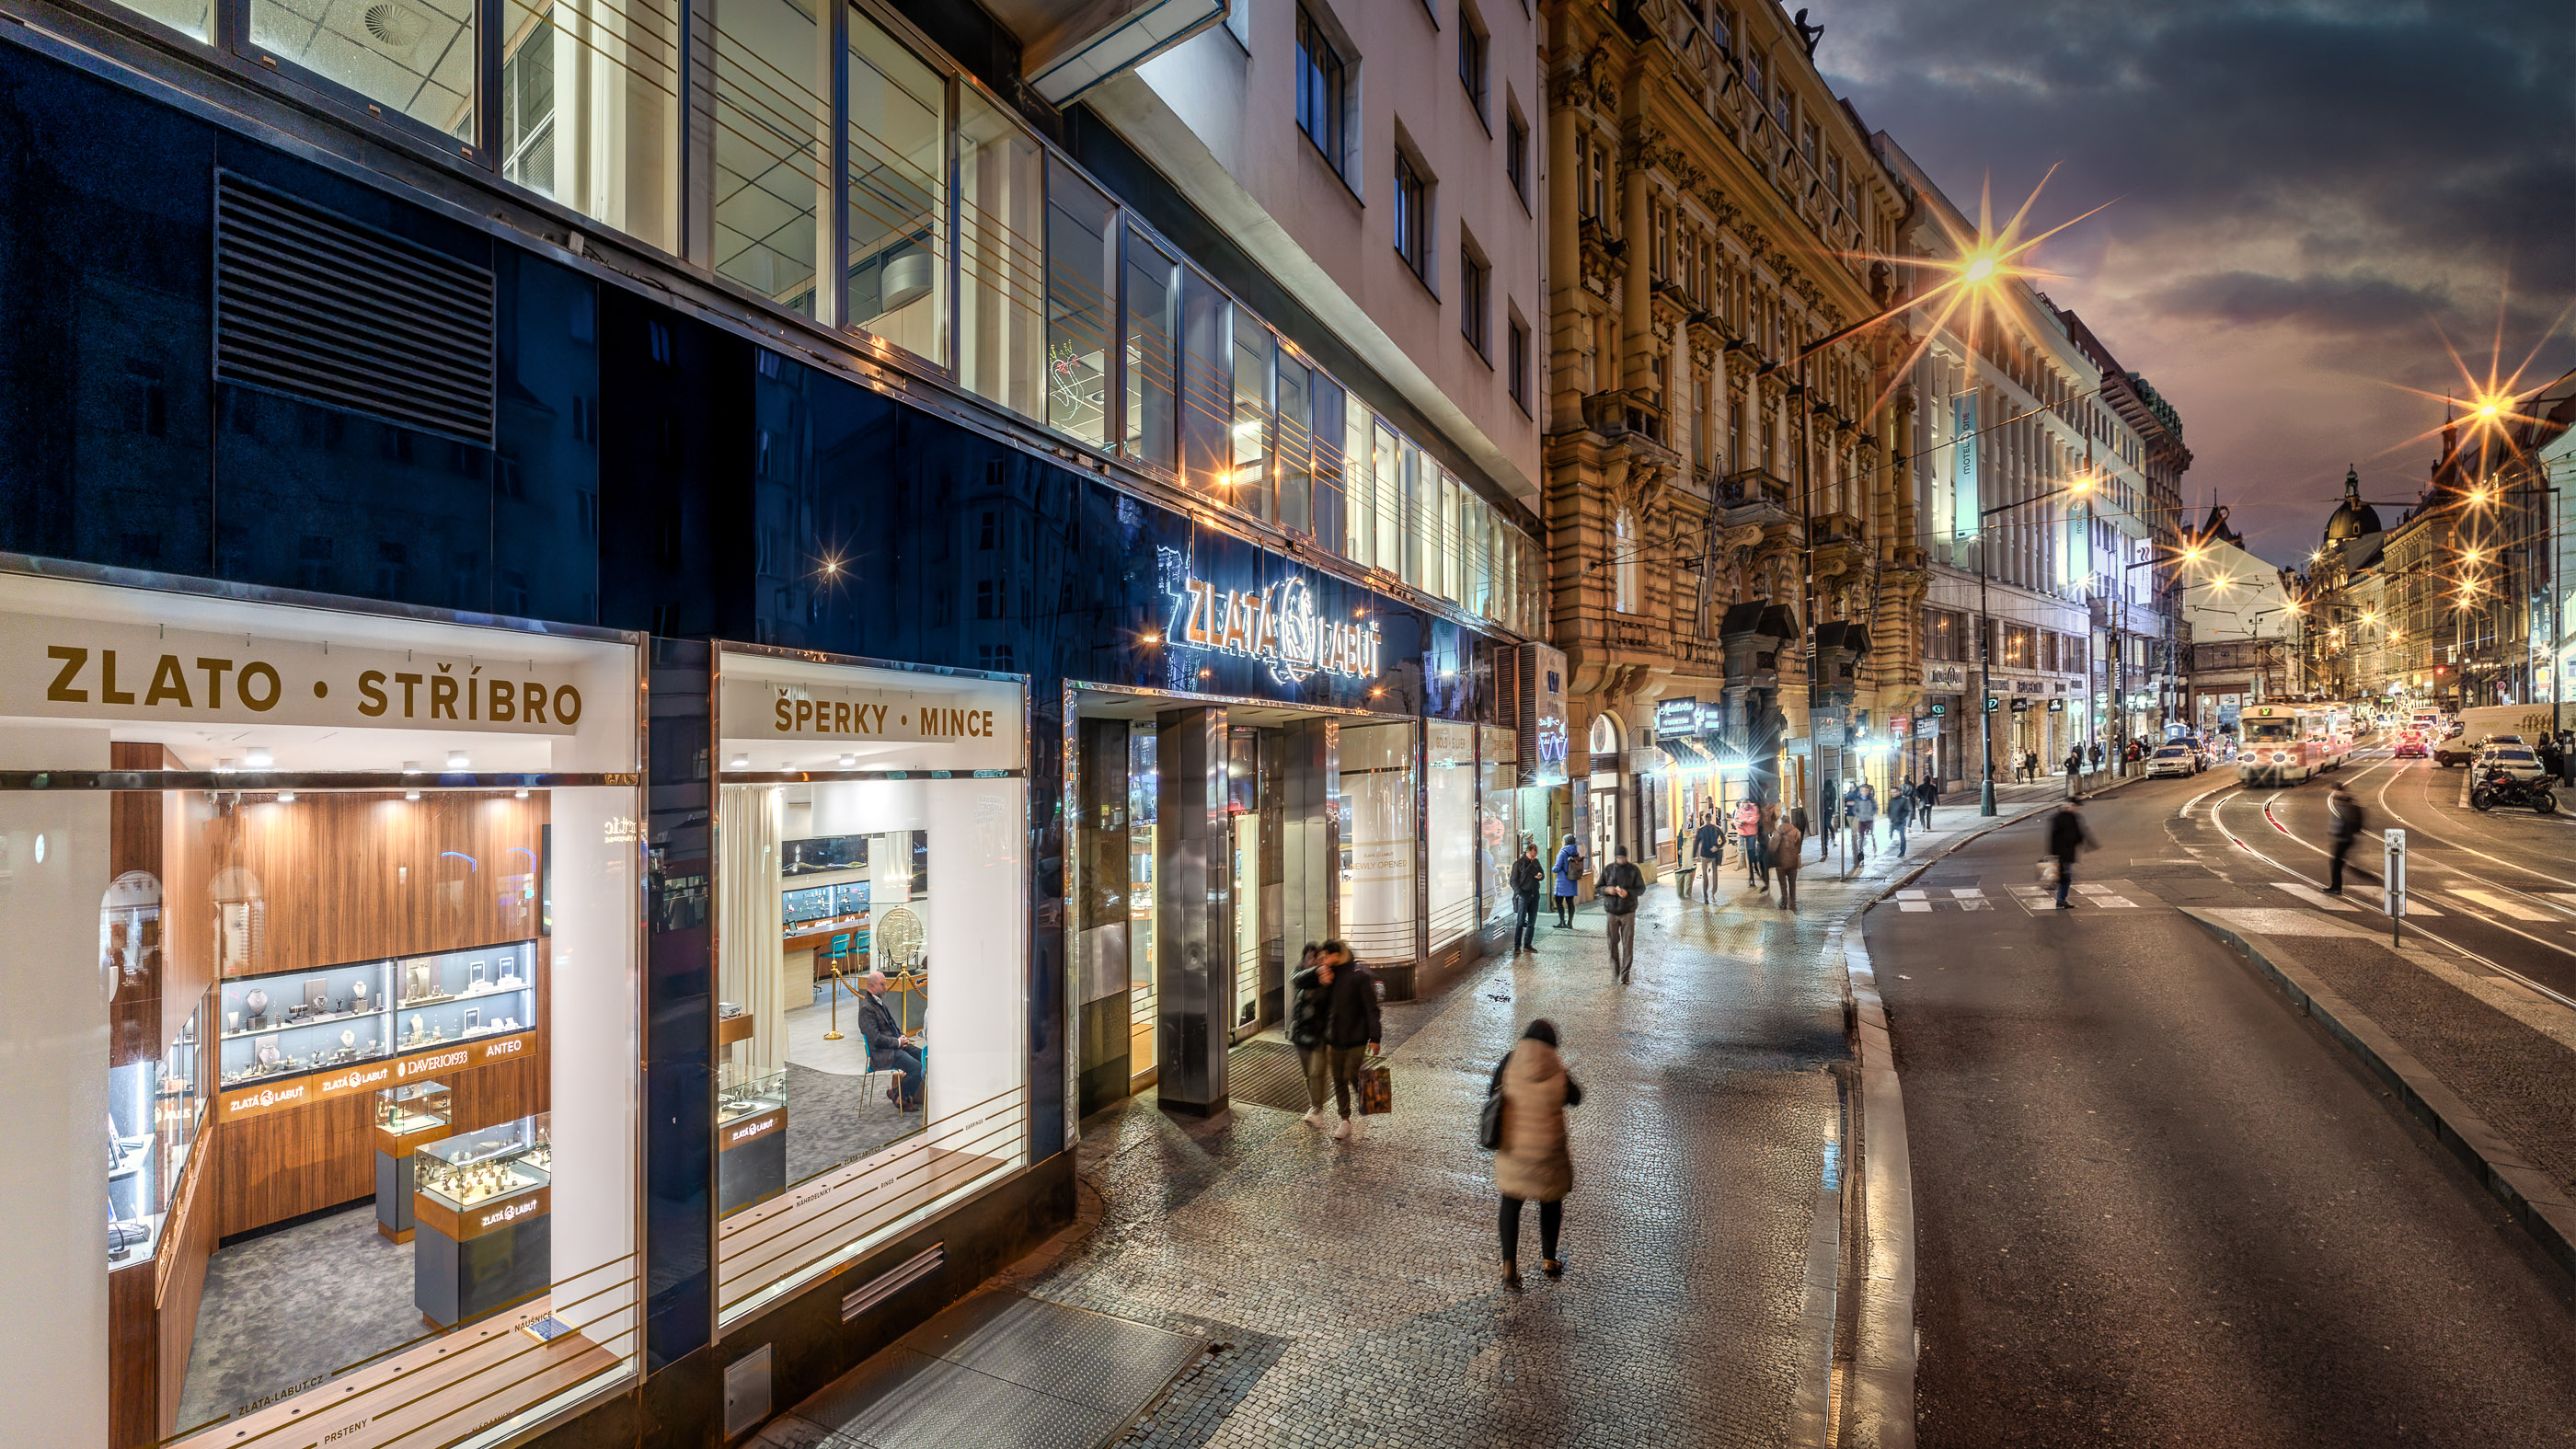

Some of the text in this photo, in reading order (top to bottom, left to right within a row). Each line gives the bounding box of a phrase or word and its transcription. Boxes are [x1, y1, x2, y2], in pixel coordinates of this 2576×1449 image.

[1185, 577, 1382, 678] ZLATÁ LABUŤ
[46, 645, 582, 726] ZLATO STŘÍBRO
[774, 688, 889, 735] ŠPERKY
[920, 707, 994, 738] MINCE
[1350, 859, 1408, 870] NEWLY OPENED
[486, 1040, 522, 1057] ANTEO
[322, 1067, 388, 1091] ZLATÁ LABUŤ
[230, 1086, 304, 1111] ZLATÁ LABUŤ
[965, 1119, 983, 1131] EARRINGS
[880, 1178, 894, 1189] RINGS
[796, 1187, 832, 1208] NÁHRDELNÍKY
[482, 1200, 537, 1227] ZLATÁ LABUŤ
[237, 1374, 324, 1417] ZLATA-LABUT.CZ
[324, 1418, 368, 1445] PRSTENY
